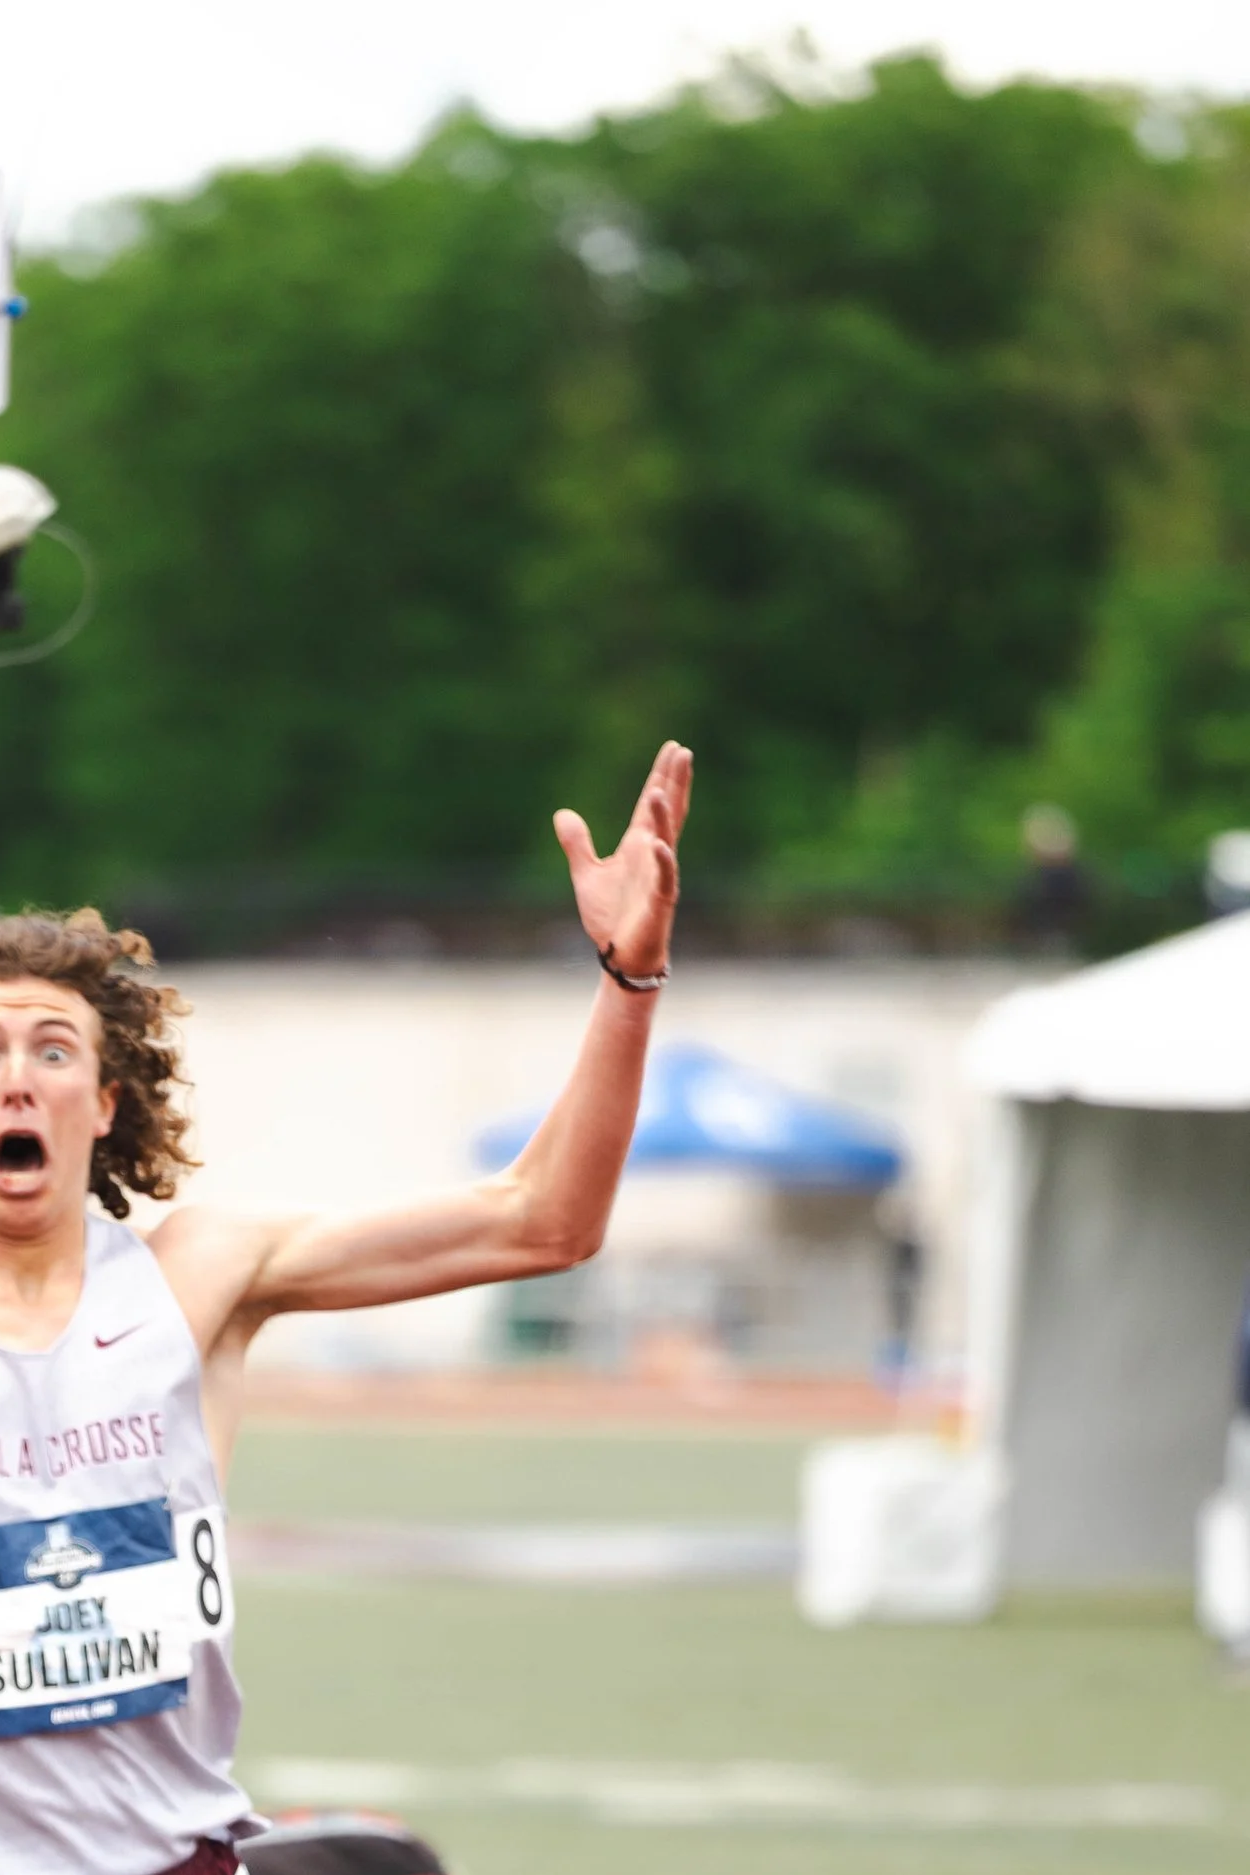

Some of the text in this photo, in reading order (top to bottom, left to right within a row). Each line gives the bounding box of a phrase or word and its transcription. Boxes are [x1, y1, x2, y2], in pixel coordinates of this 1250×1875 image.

[46, 1413, 165, 1477] CROSSE
[193, 1518, 223, 1626] 8
[37, 1596, 108, 1635] JOEY
